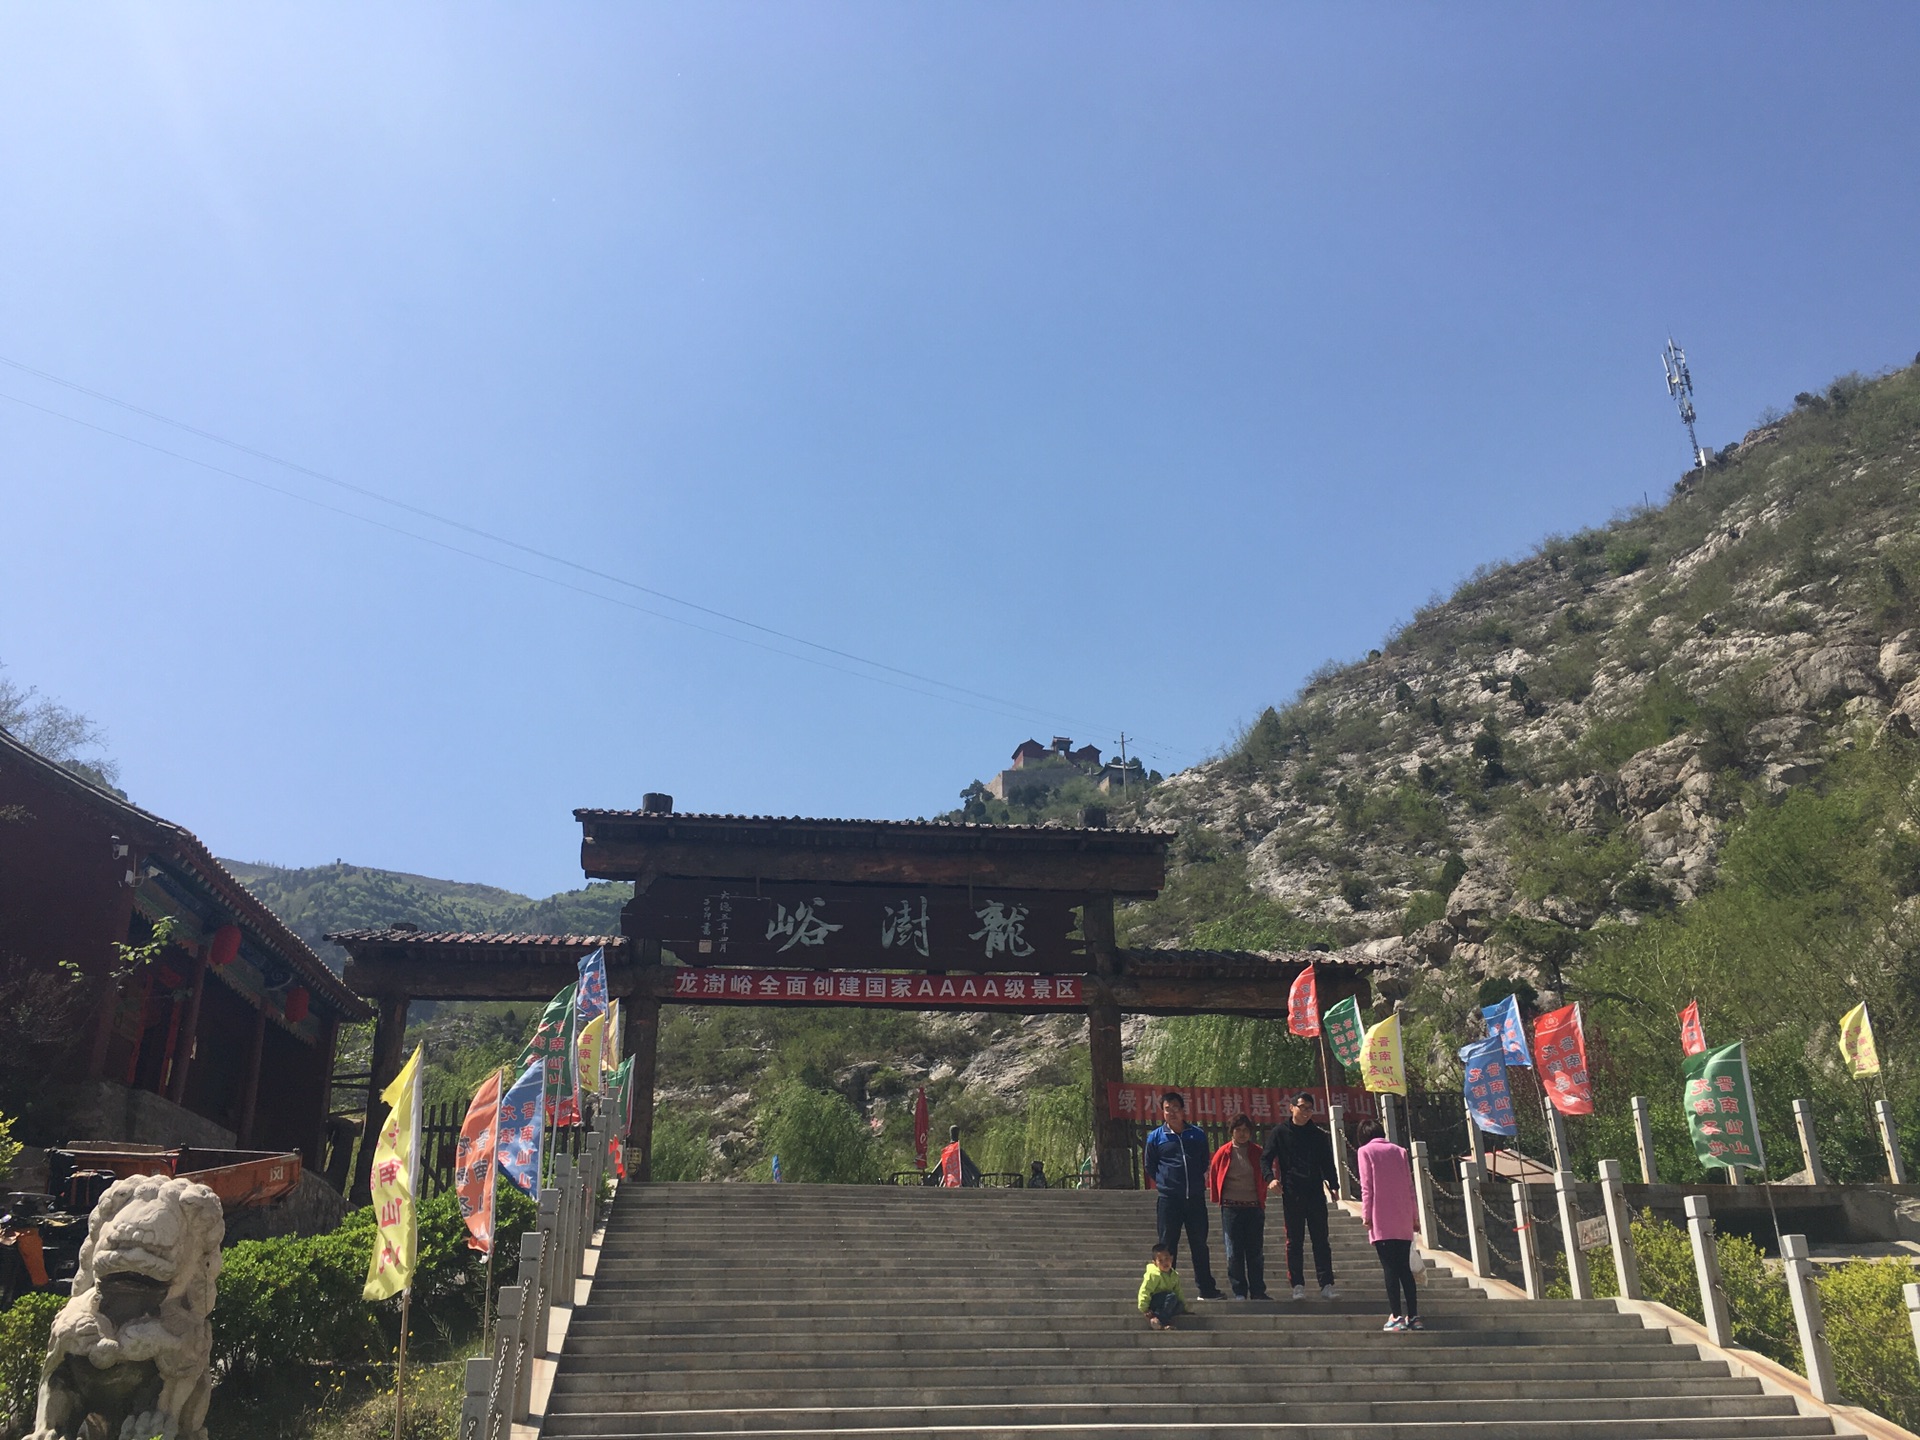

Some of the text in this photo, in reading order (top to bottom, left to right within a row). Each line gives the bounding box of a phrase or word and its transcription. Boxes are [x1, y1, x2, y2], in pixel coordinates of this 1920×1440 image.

[676, 972, 1076, 999] 龙澍峪全面创建国家AAAA级景区
